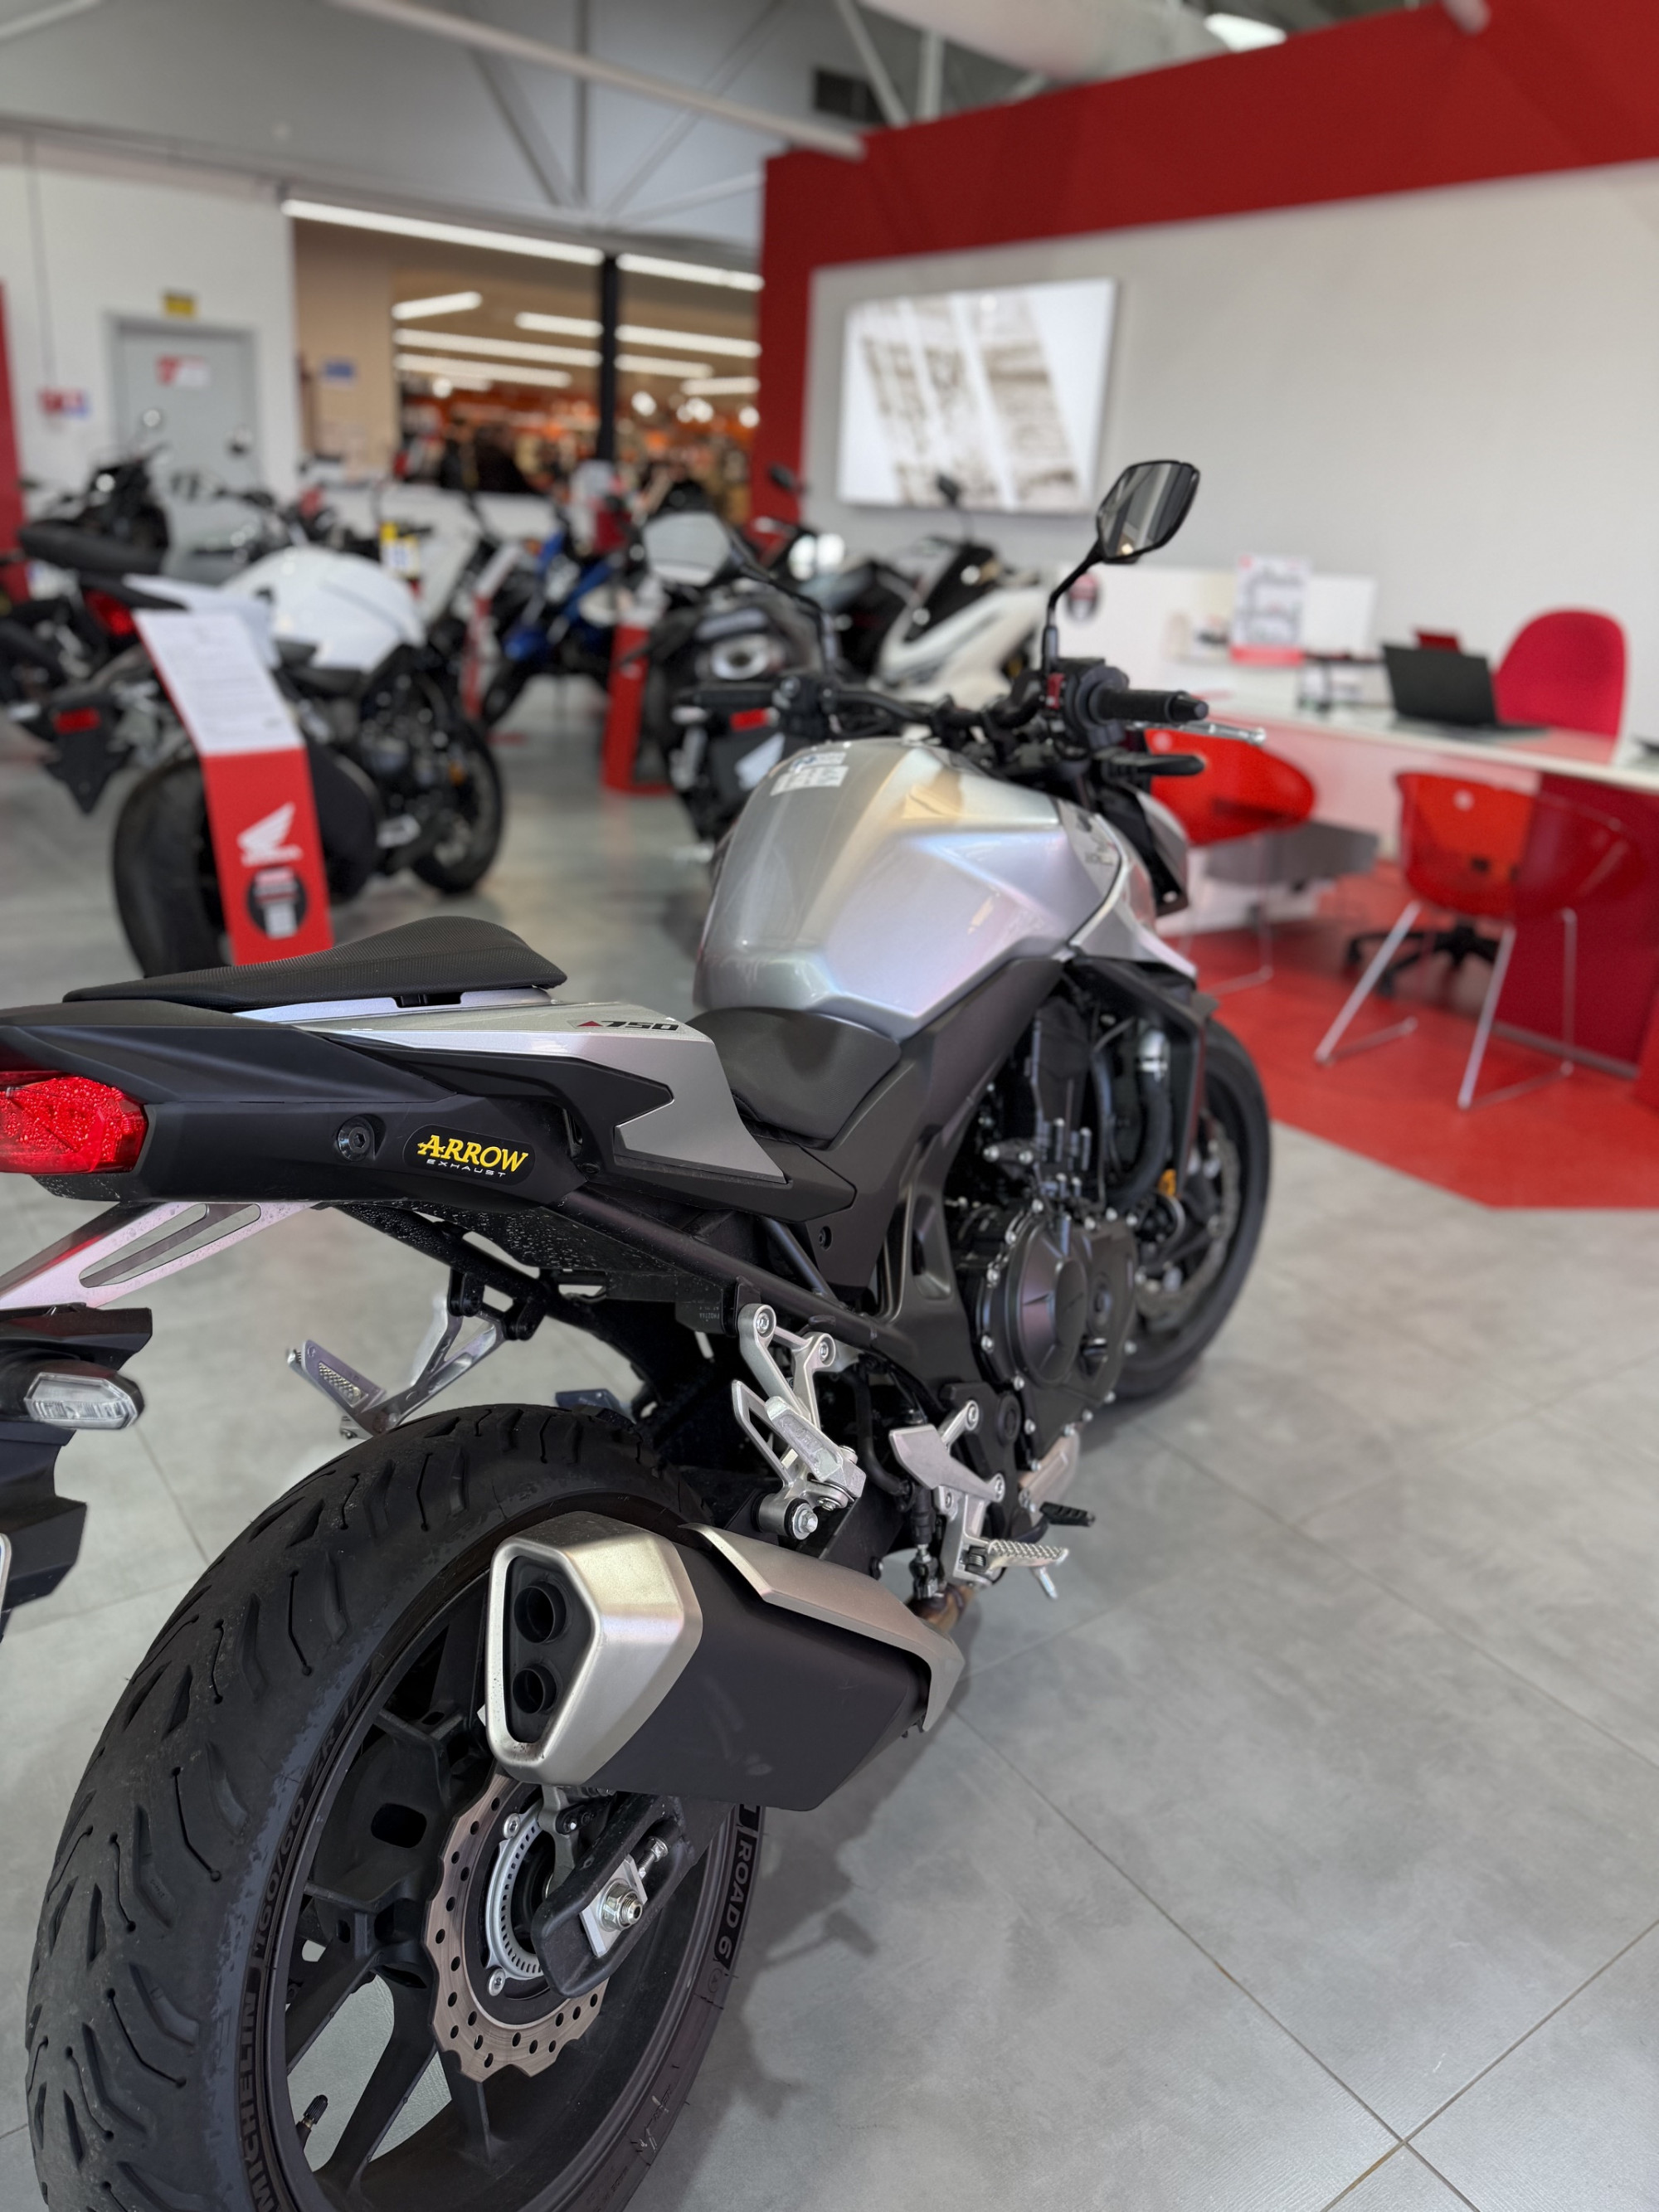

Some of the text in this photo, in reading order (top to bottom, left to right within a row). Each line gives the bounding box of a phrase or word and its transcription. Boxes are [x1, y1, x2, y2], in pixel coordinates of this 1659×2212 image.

[601, 1020, 679, 1031] 750
[417, 1135, 528, 1172] ARROW
[426, 1159, 506, 1178] EXHAUST
[726, 1839, 753, 1928] ROAD
[718, 1935, 733, 1960] 6
[239, 1991, 276, 2212] MICHELIN
